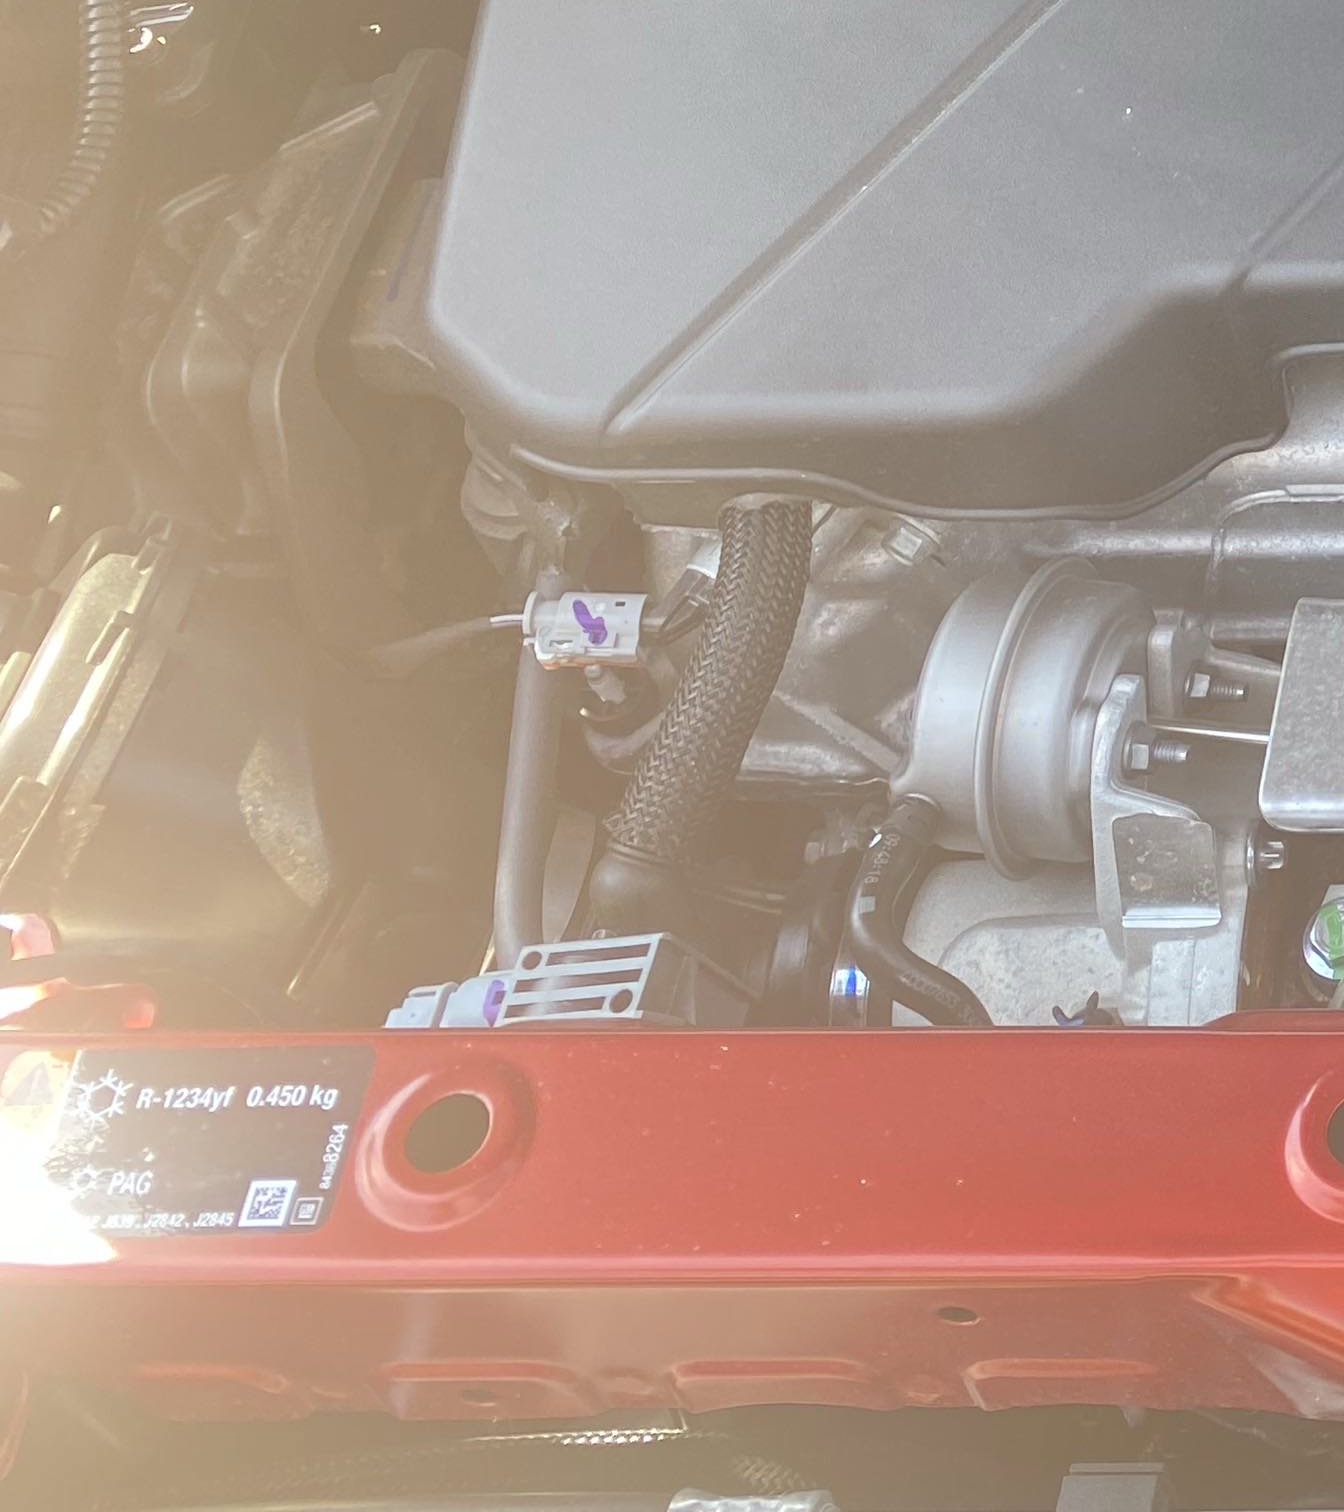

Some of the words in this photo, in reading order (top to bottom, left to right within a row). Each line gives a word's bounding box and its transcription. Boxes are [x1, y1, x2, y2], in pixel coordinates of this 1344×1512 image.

[136, 1086, 235, 1112] R-1234yf
[246, 1086, 306, 1108] 0.450
[310, 1084, 338, 1111] kg
[107, 1170, 153, 1196] PAG
